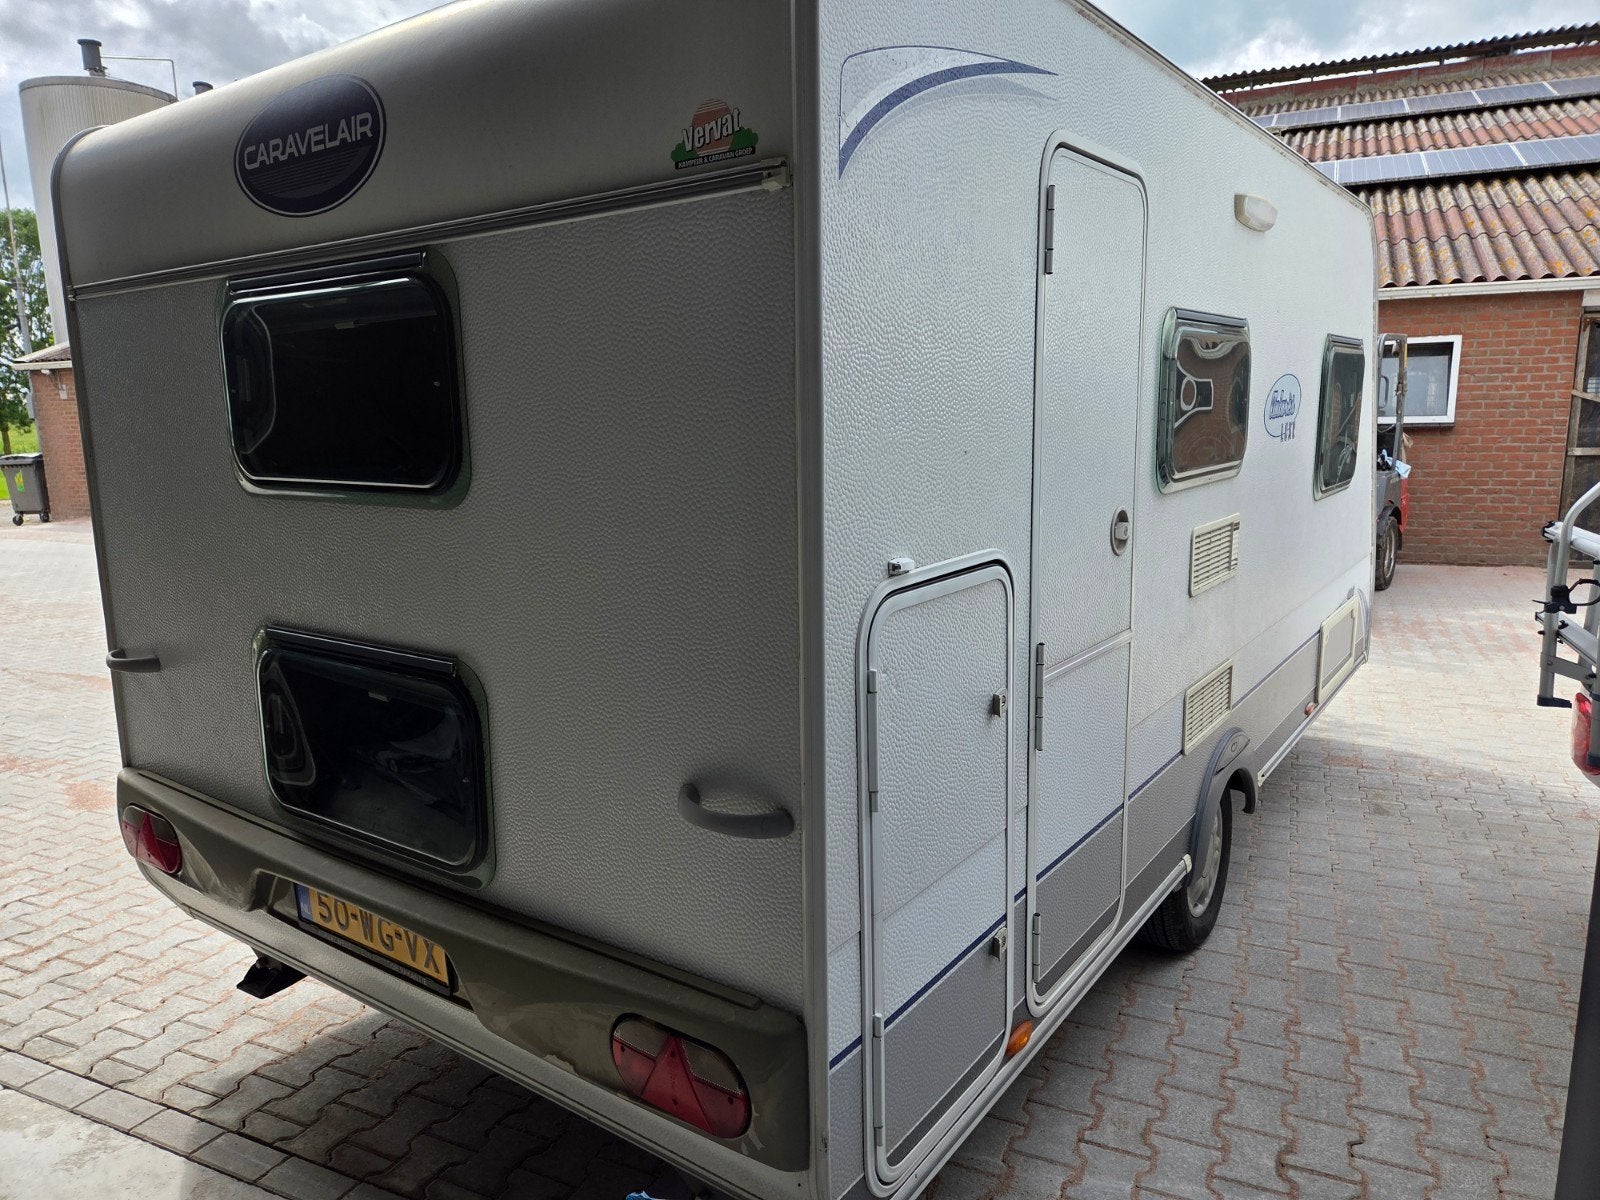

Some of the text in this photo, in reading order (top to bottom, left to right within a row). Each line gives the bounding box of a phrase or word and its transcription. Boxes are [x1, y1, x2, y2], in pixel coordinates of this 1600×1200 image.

[244, 112, 373, 170] CARAVELAIR
[682, 108, 740, 152] Vervat
[735, 147, 753, 157] GROEP
[316, 892, 440, 974] 50-WG-VX
